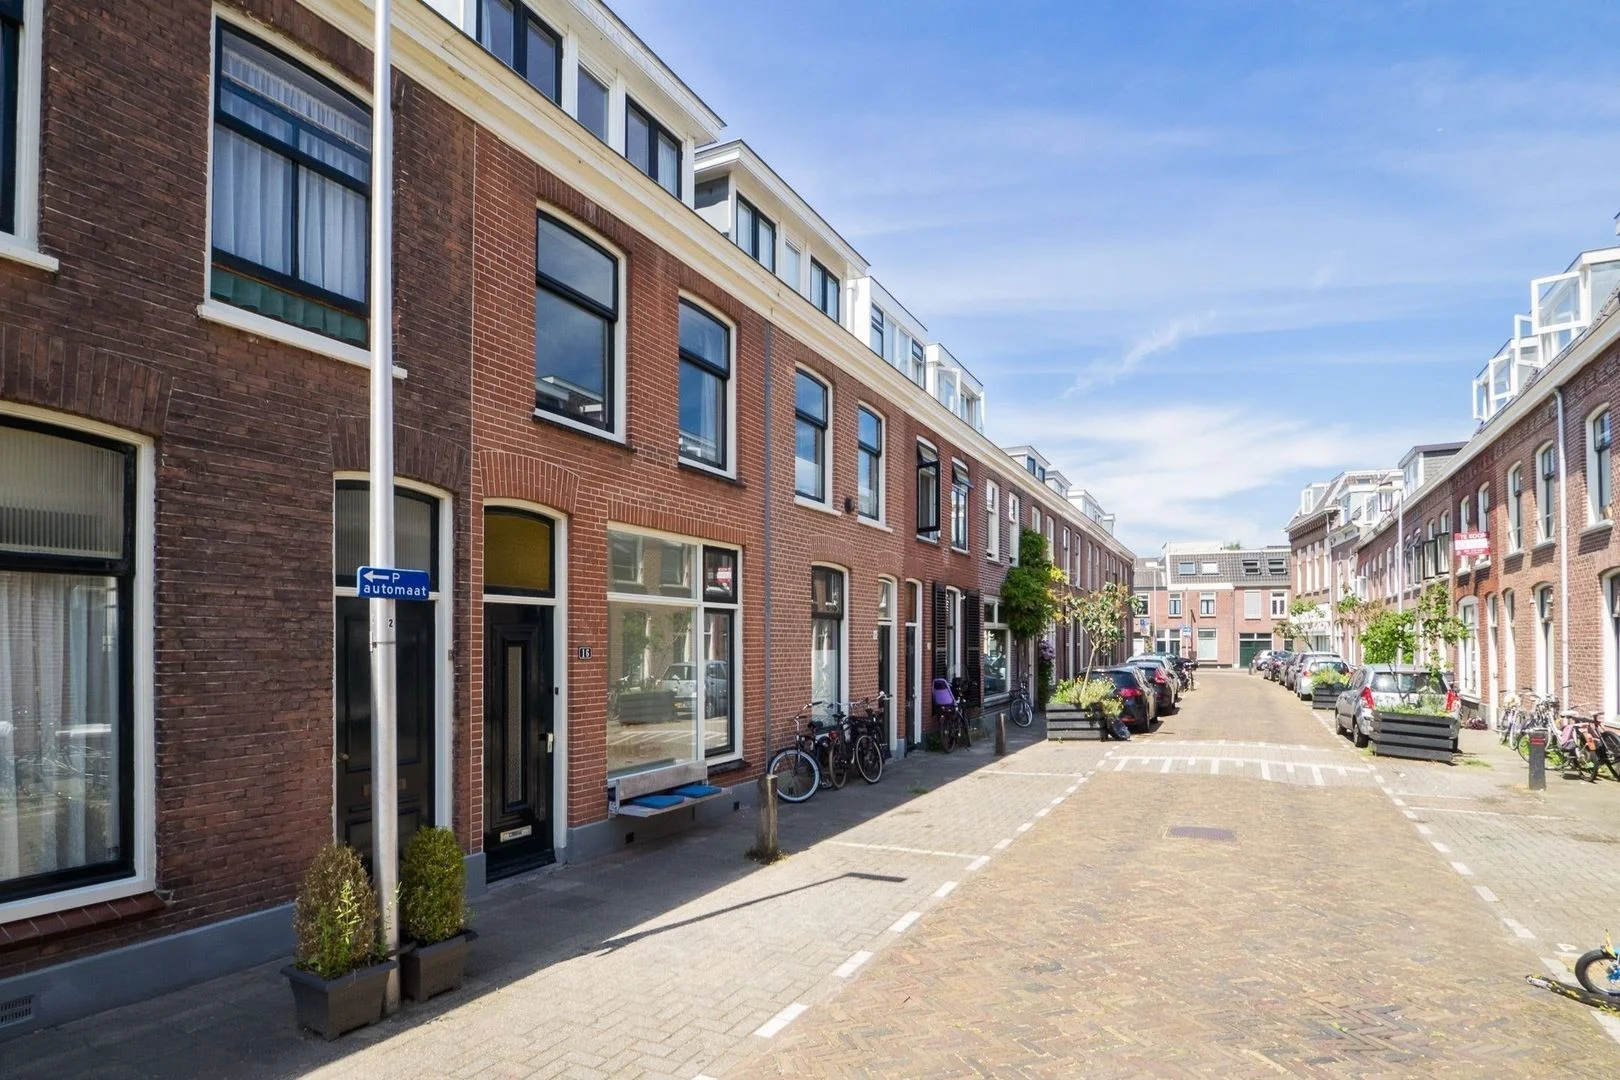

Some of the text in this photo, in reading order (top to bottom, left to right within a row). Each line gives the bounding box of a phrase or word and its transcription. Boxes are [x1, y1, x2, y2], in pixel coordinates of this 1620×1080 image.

[392, 573, 400, 583] P
[363, 583, 427, 596] automaat
[388, 619, 393, 628] 2
[582, 649, 590, 658] 16
